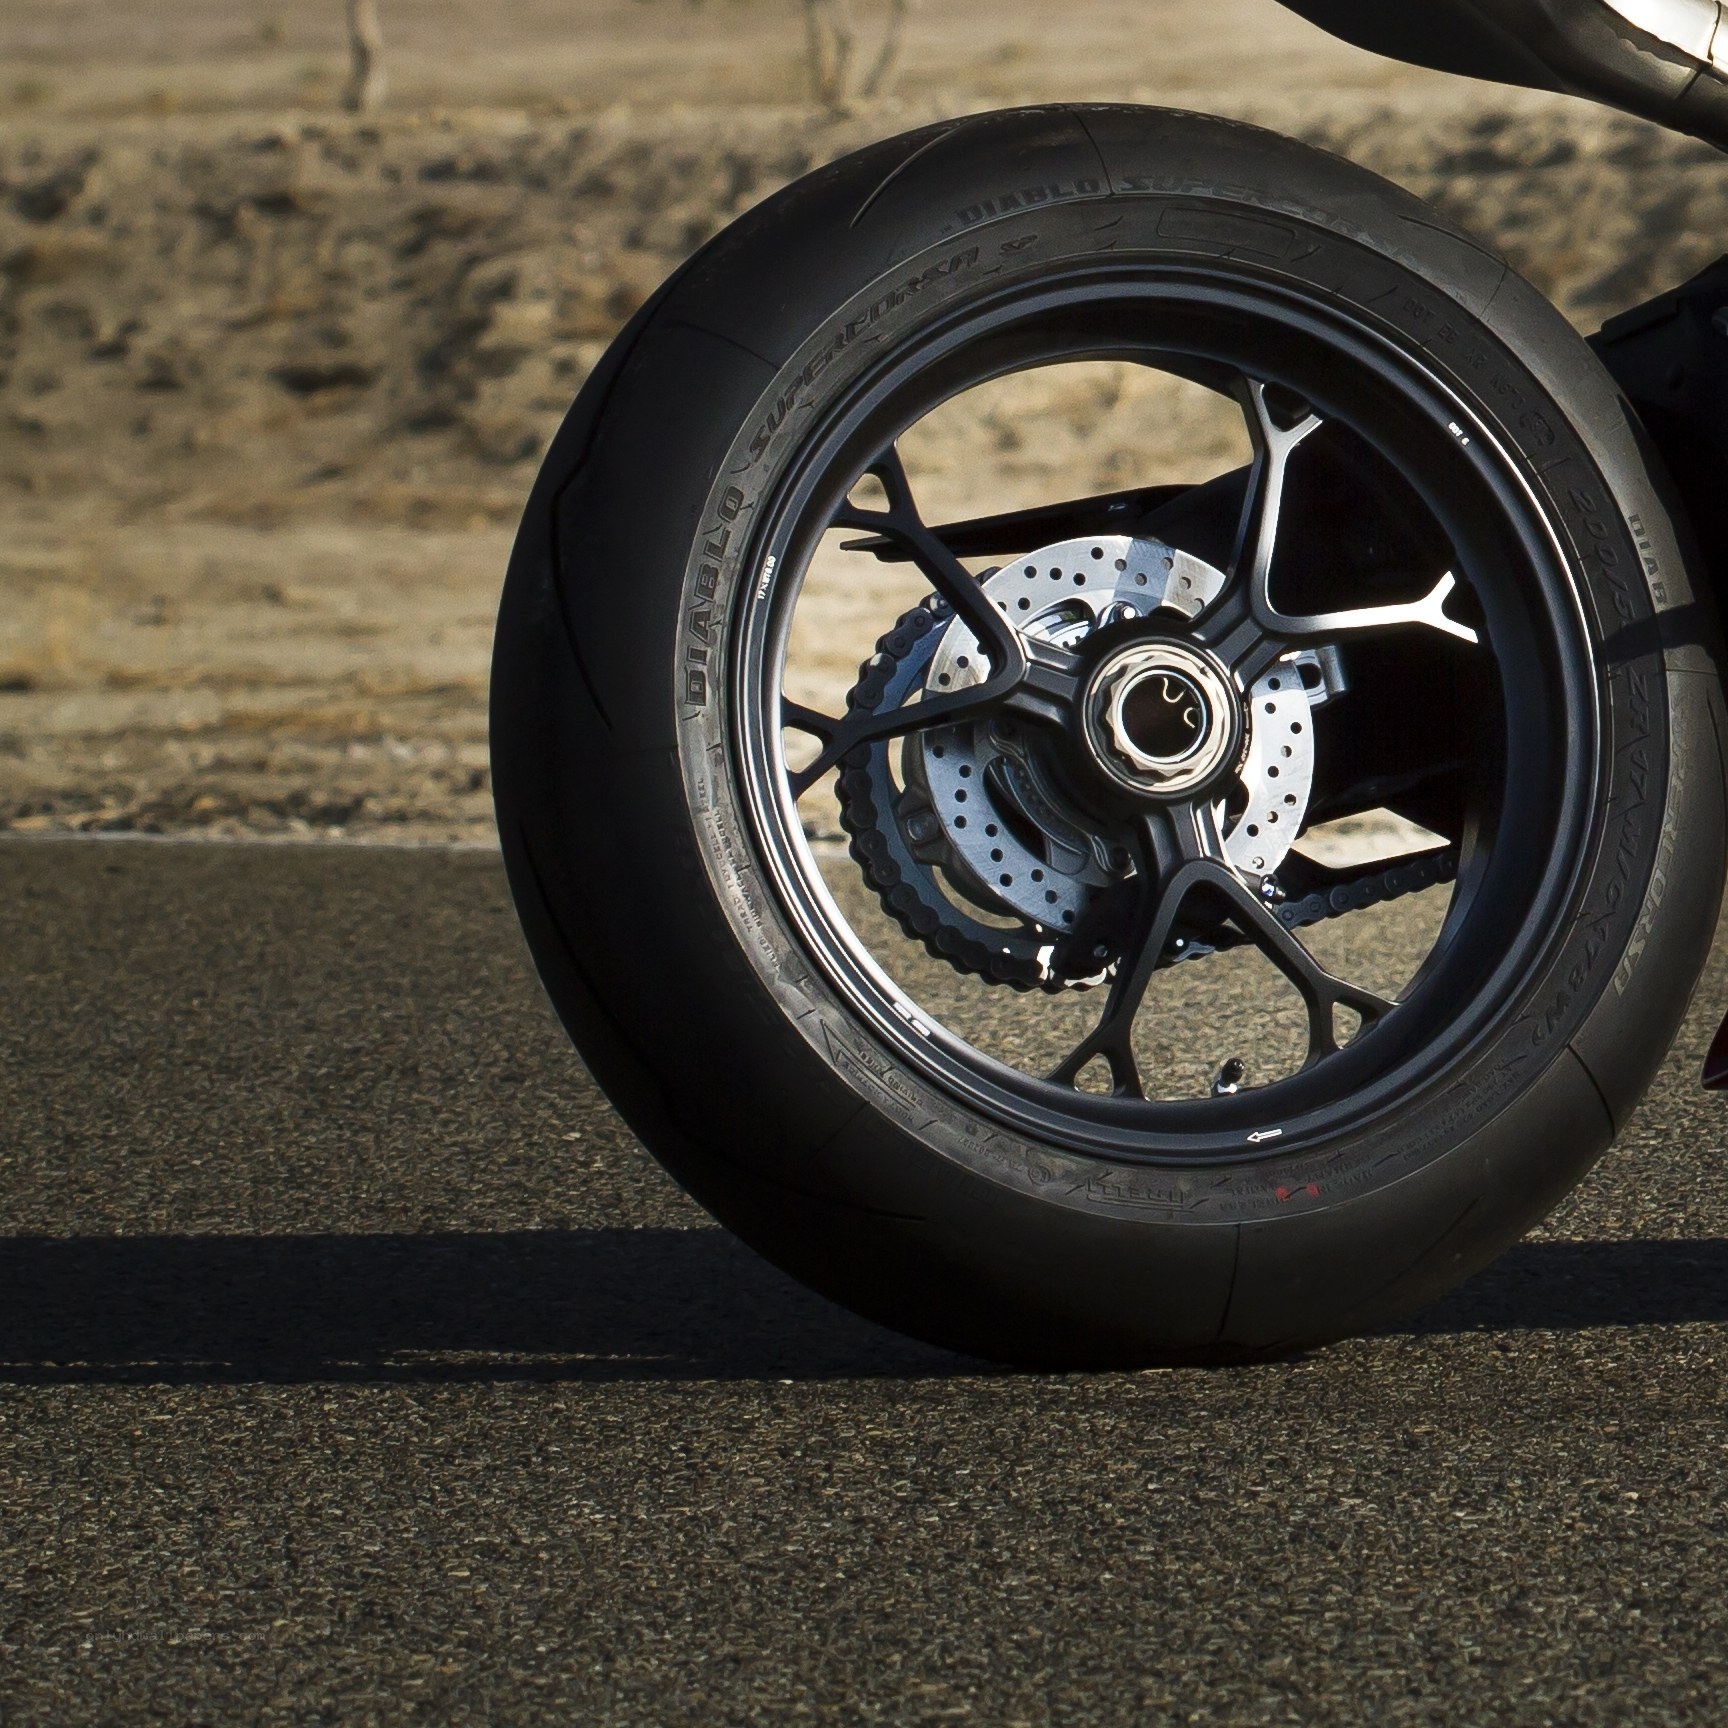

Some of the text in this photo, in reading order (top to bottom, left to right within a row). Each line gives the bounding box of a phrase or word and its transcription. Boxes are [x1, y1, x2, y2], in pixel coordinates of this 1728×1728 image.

[957, 177, 1100, 228] DIABLO
[685, 481, 748, 708] DIABLO
[742, 244, 981, 465] SUPERCORSA
[1626, 512, 1667, 604] DIAB
